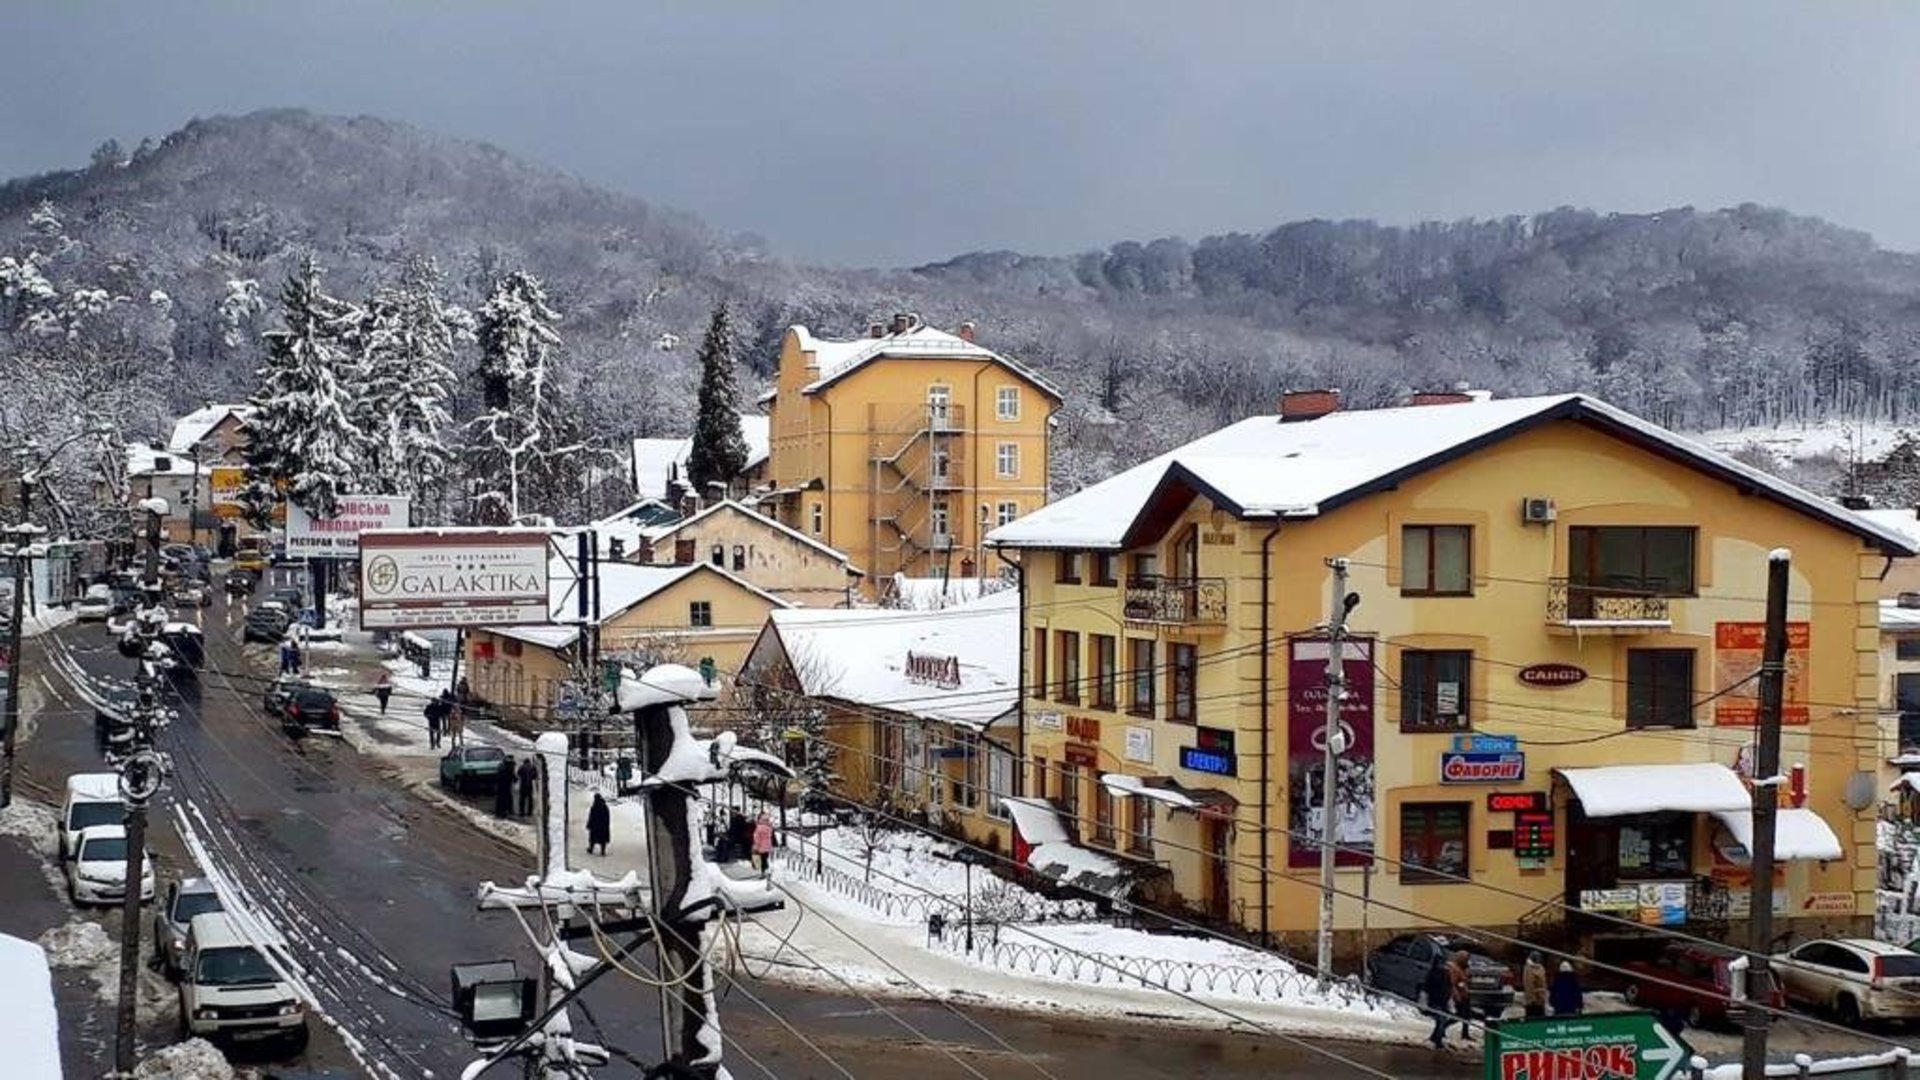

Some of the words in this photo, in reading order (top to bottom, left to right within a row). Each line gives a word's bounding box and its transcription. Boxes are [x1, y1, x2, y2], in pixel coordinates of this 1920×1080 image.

[420, 554, 451, 562] HOTEL
[401, 573, 541, 594] GALAKTIKA
[904, 649, 961, 685] АПТЕКА
[1501, 1044, 1637, 1080] РИНОК
